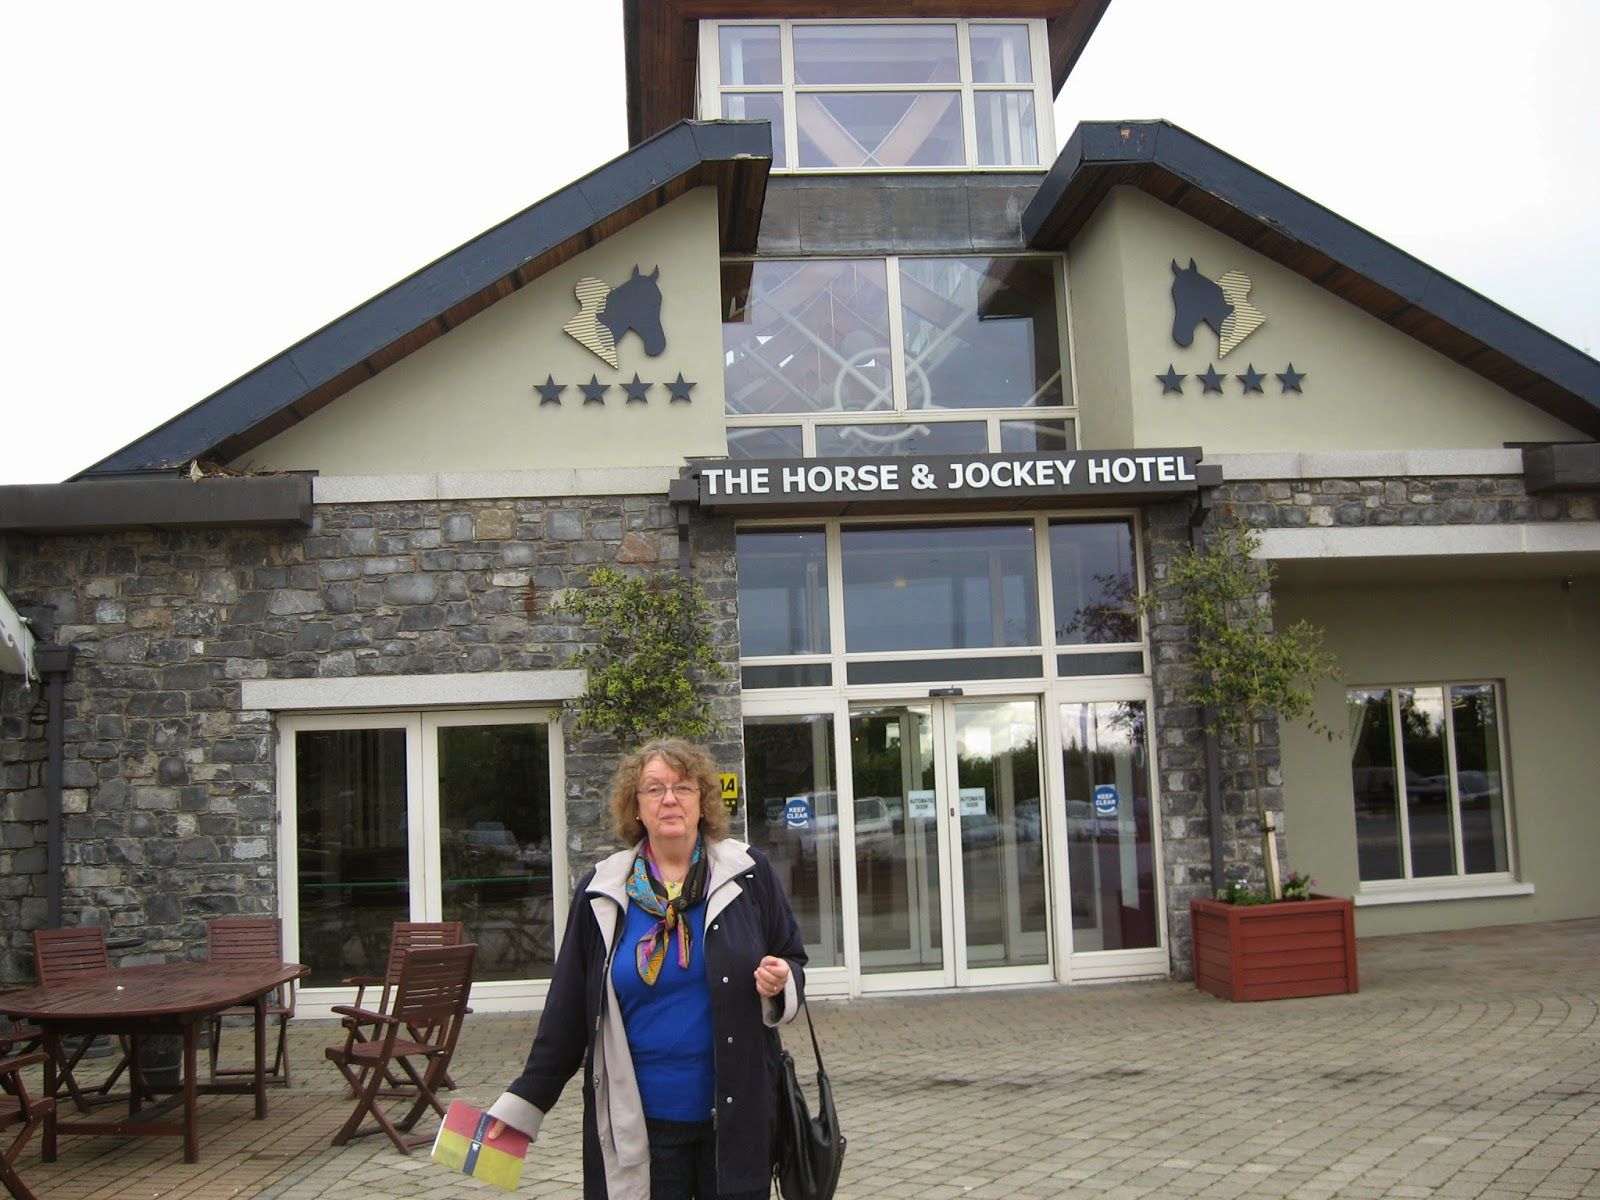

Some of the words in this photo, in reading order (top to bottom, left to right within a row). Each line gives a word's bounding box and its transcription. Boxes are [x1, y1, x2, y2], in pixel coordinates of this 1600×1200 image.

[701, 468, 770, 495] THE
[782, 464, 900, 493] HORSE
[910, 463, 938, 490] &
[948, 459, 1077, 489] JOCKEY
[1087, 456, 1196, 484] HOTEL
[786, 812, 808, 820] CLEAR
